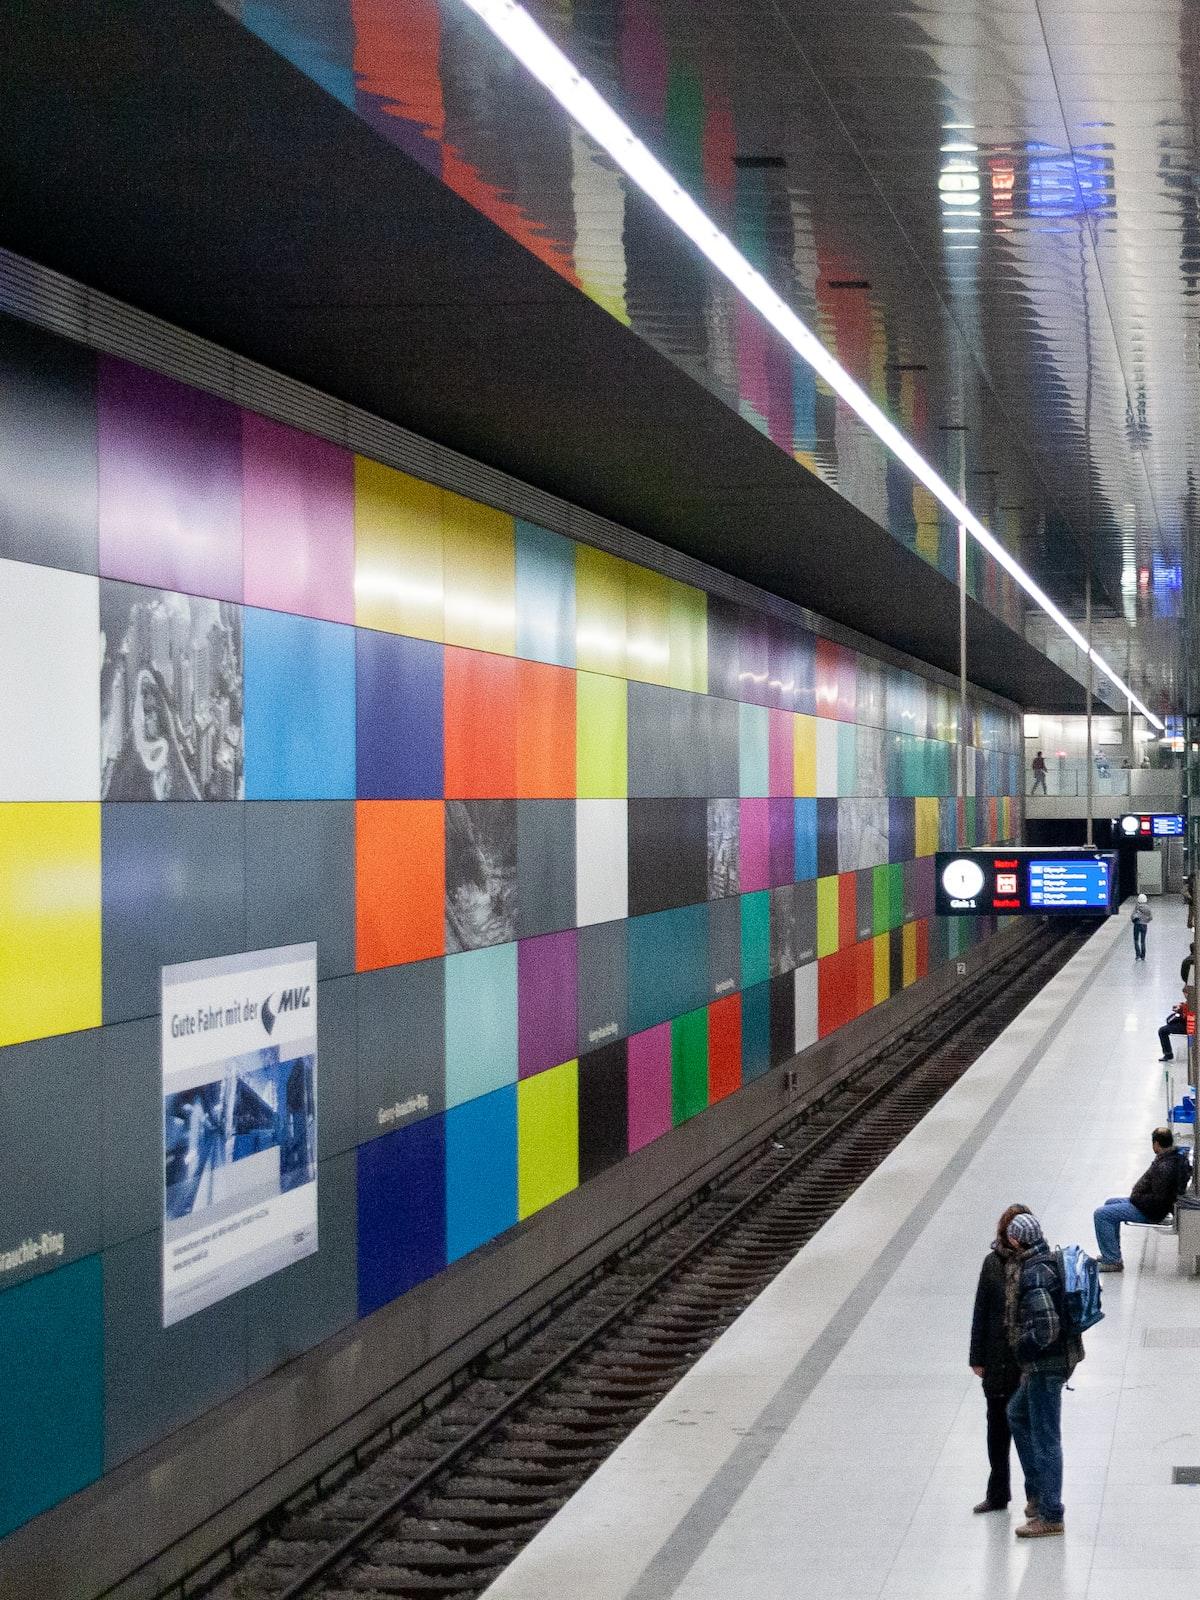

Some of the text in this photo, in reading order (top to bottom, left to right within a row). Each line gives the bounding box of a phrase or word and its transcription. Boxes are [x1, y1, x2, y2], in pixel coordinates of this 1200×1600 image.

[171, 985, 311, 1038] Gute Fahrt mit der MVG
